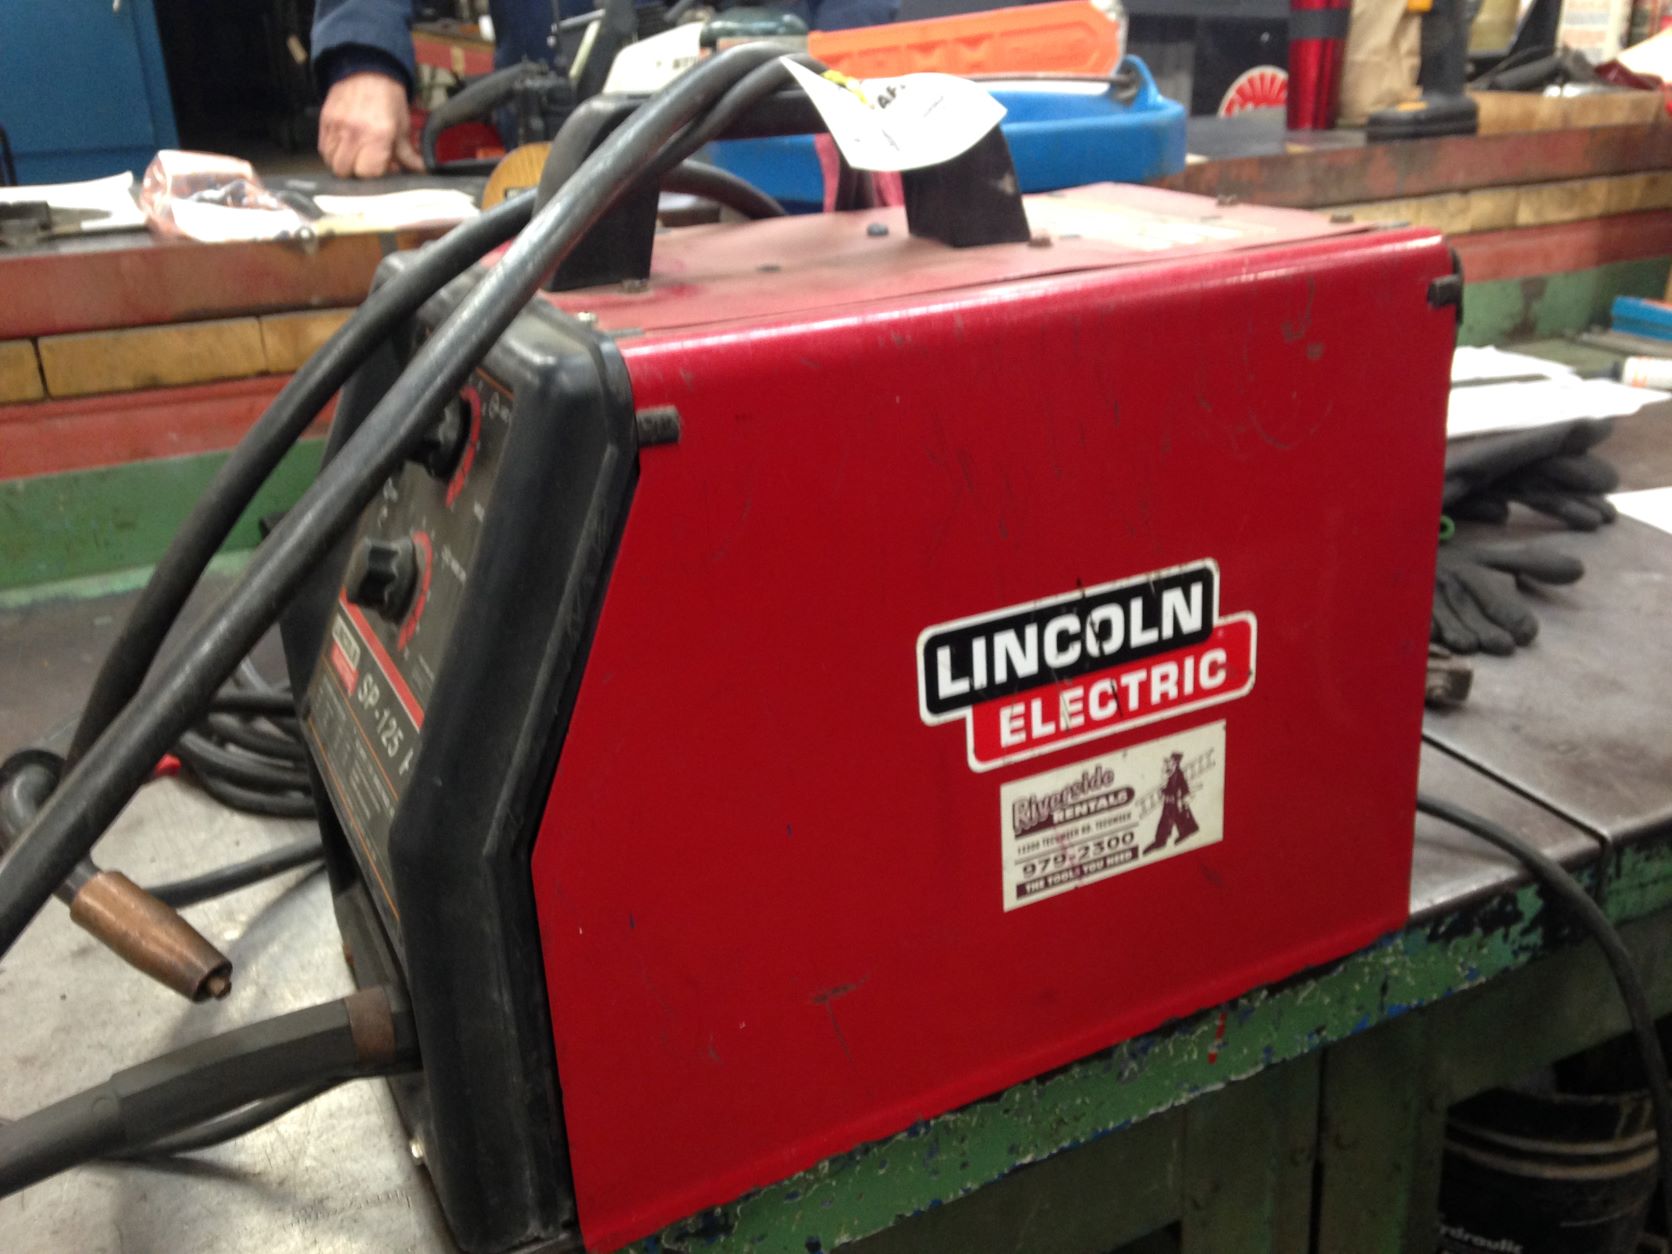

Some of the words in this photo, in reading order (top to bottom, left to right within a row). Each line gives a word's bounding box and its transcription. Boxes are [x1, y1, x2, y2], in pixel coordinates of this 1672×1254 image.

[936, 581, 1203, 700] LINCOLN
[1000, 648, 1228, 748] ELECTRIC
[1012, 763, 1115, 836] Riverside
[1050, 789, 1129, 825] RENTALS
[1022, 831, 1135, 878] 979-2300
[1025, 878, 1046, 894] THE
[1082, 859, 1104, 875] YOU
